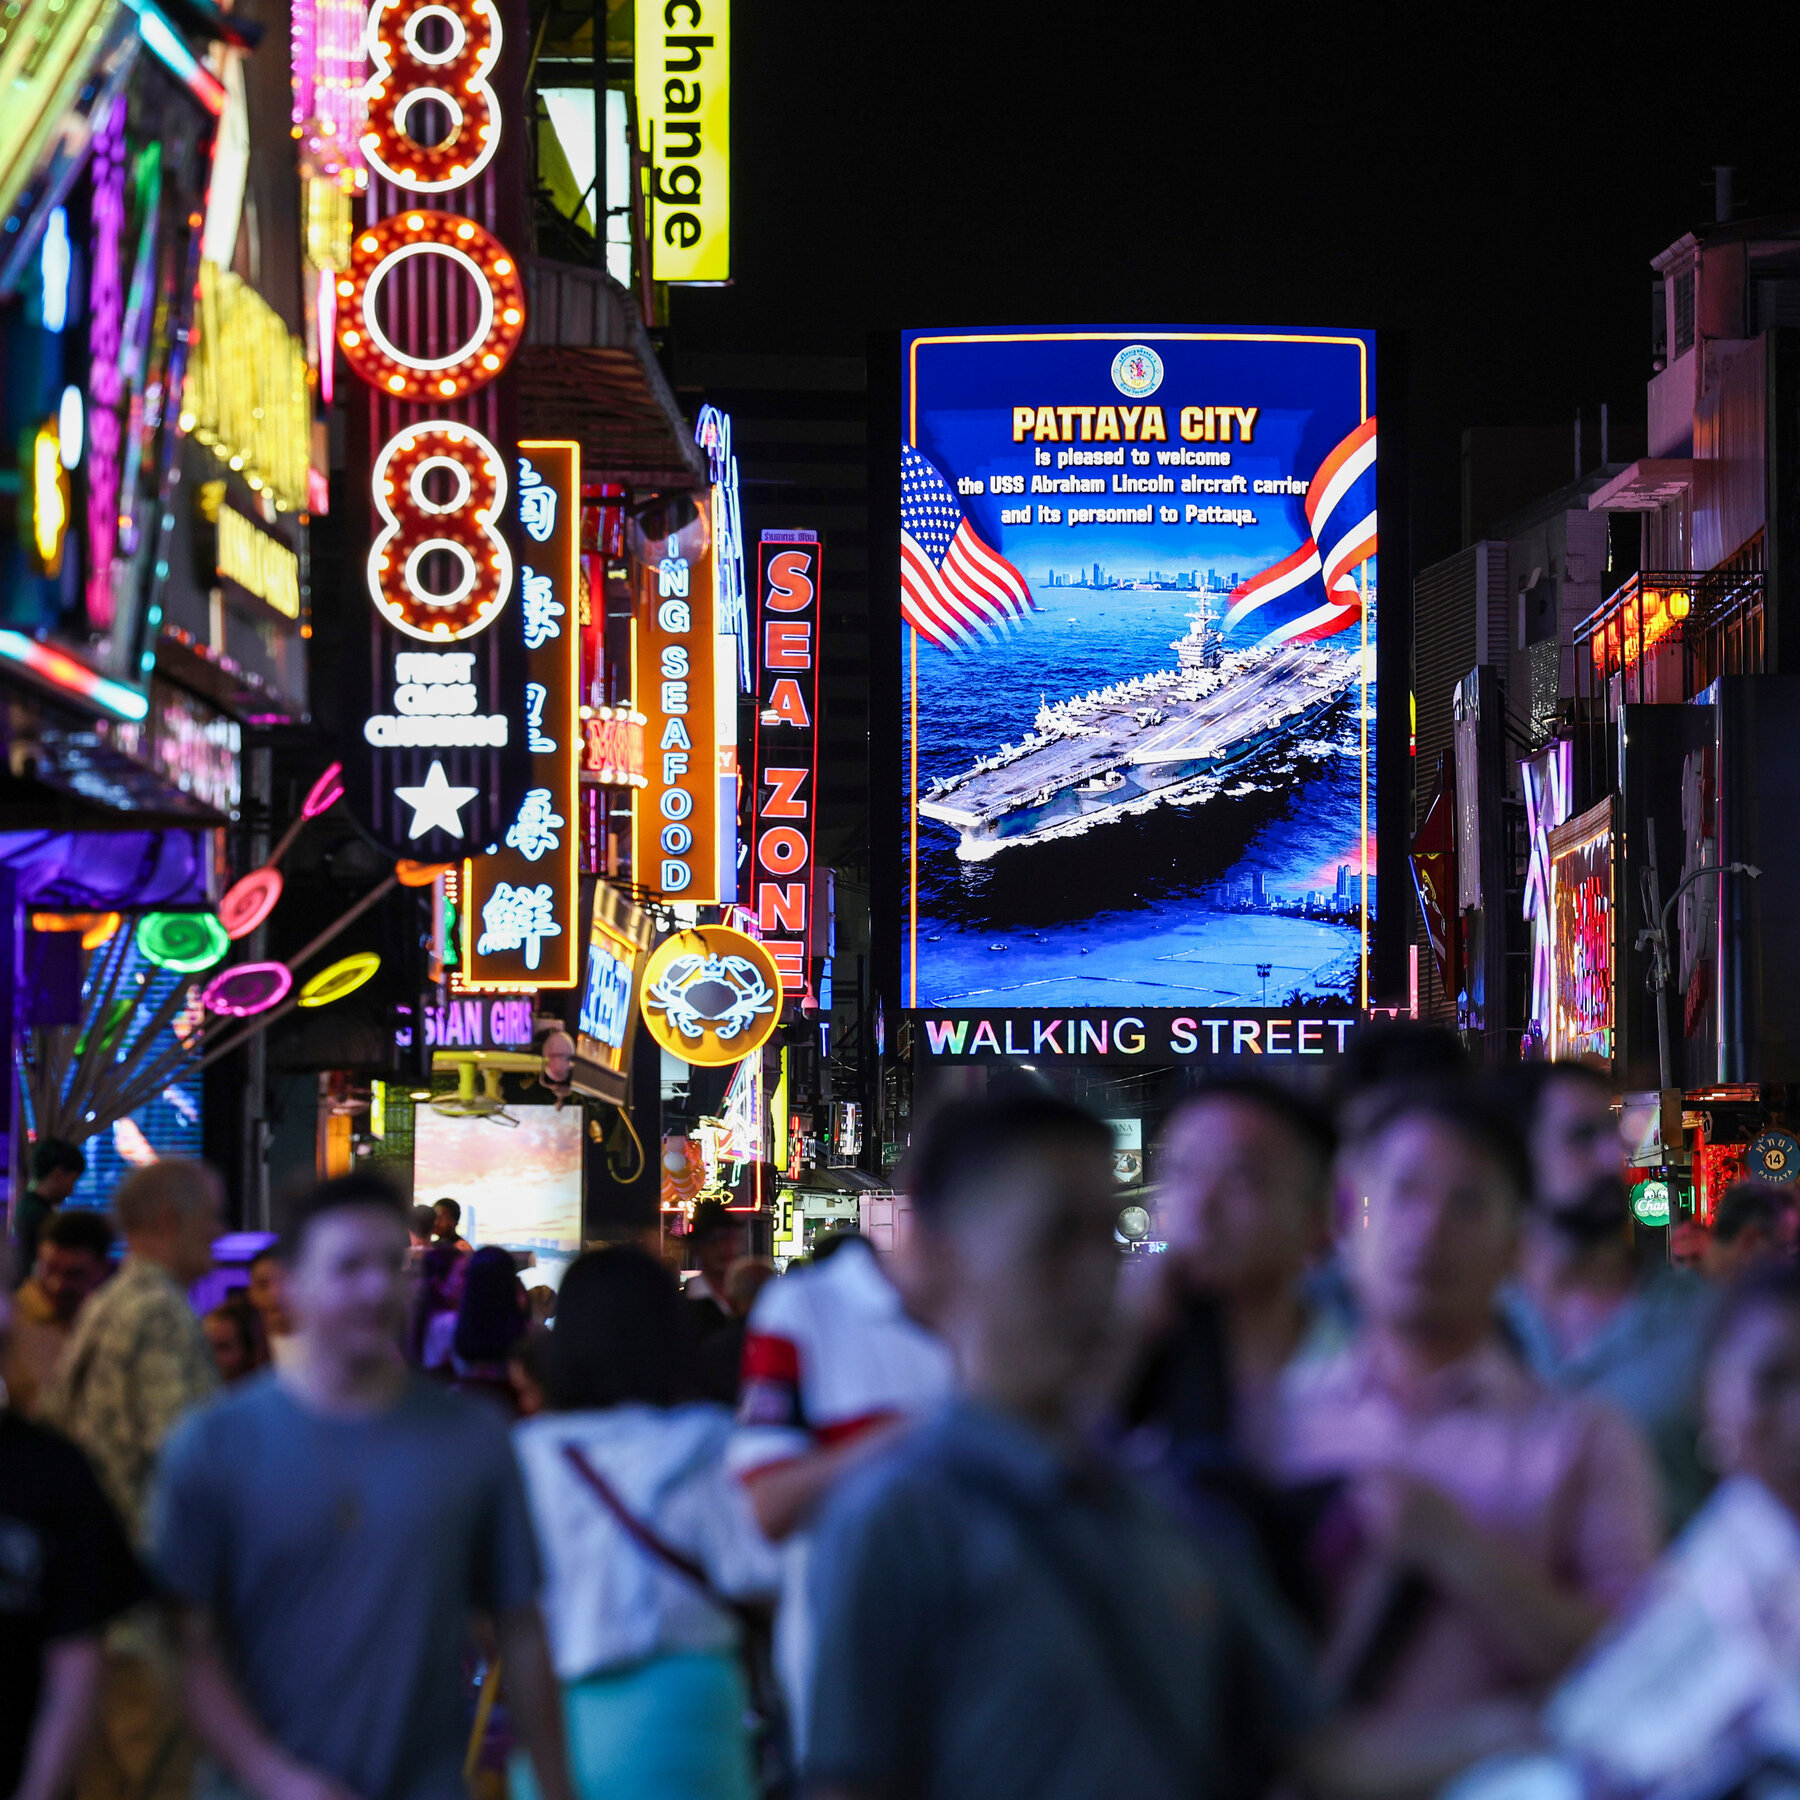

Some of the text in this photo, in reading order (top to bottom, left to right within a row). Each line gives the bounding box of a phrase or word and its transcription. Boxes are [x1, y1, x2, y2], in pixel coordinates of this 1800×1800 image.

[1012, 406, 1258, 441] PATTAYA CITY
[1035, 447, 1231, 469] is pleased to welcome
[957, 474, 1310, 494] the USS Abraham Lincoln aircraft carrier
[1001, 504, 1258, 526] and its personnel to Pattaya.
[660, 645, 693, 893] SEAFOOD
[757, 551, 814, 989] SEA ZONE
[926, 1018, 1354, 1055] WALKING STREET
[1767, 1153, 1782, 1166] 14
[1759, 1170, 1793, 1182] PATTAYA
[1637, 1199, 1669, 1212] Chan
